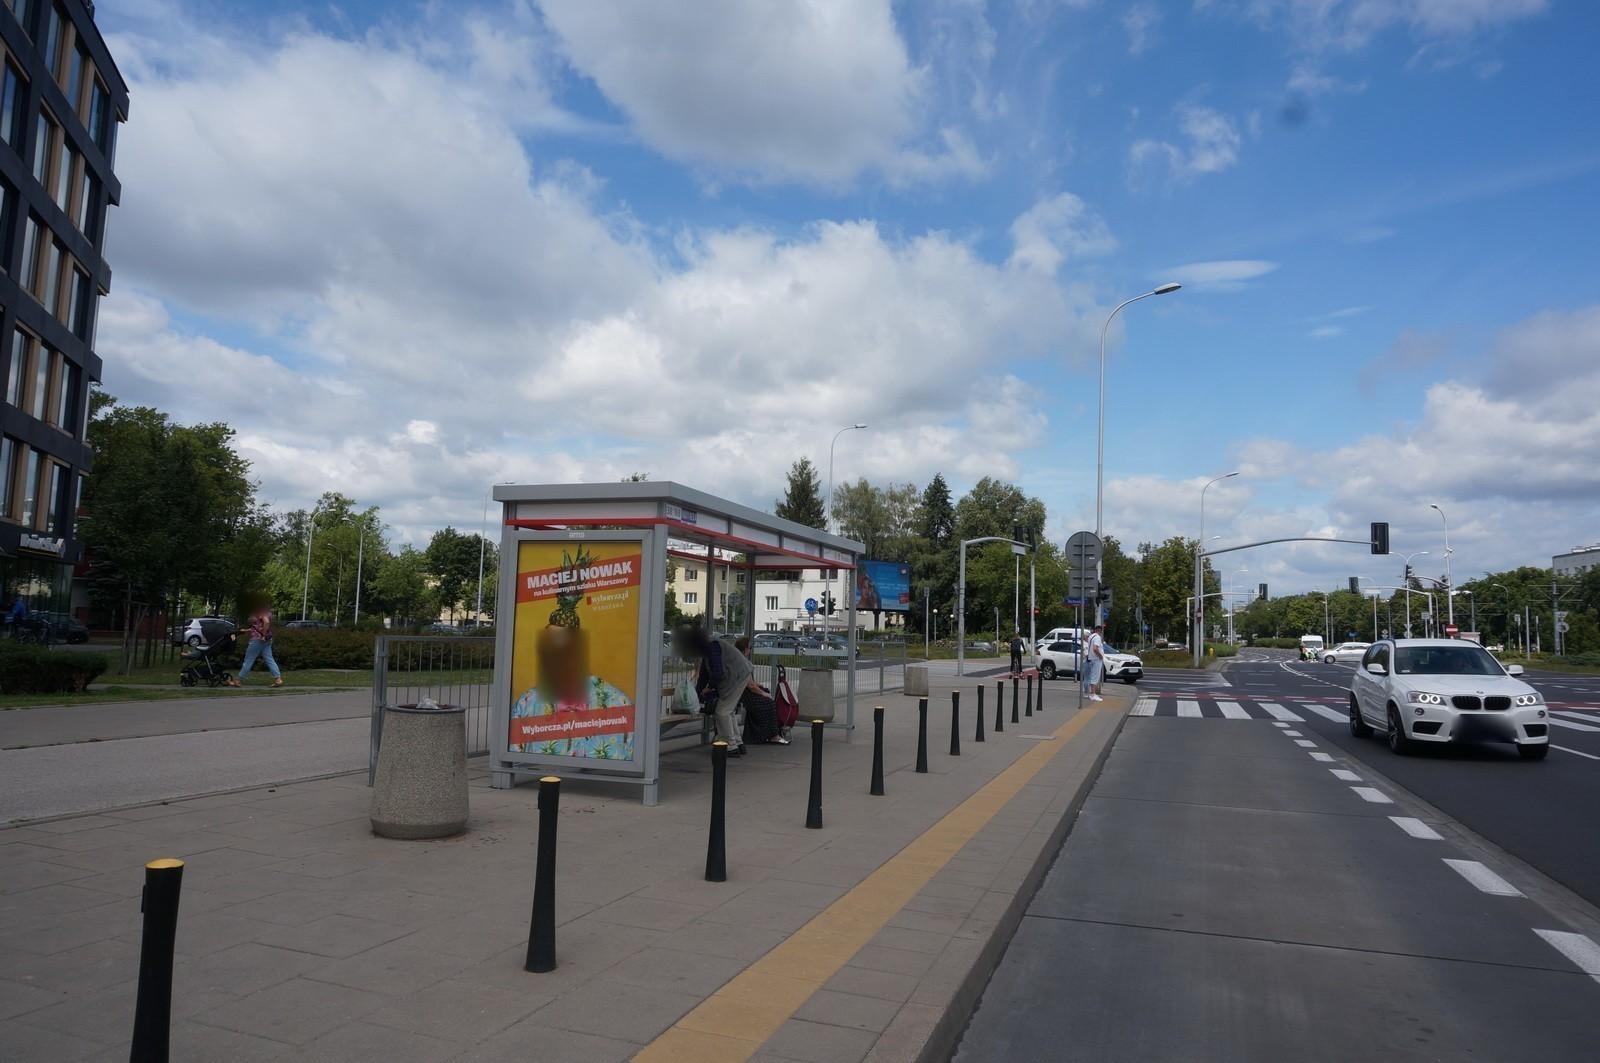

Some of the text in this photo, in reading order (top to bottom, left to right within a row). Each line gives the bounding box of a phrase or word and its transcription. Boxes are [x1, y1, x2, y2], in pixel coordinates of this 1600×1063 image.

[527, 561, 632, 588] MACIEJ NOWAK
[543, 586, 576, 595] kulinarnym
[596, 577, 628, 586] Warszawy
[522, 716, 627, 734] Wyborcza.pl/maciejnowak
